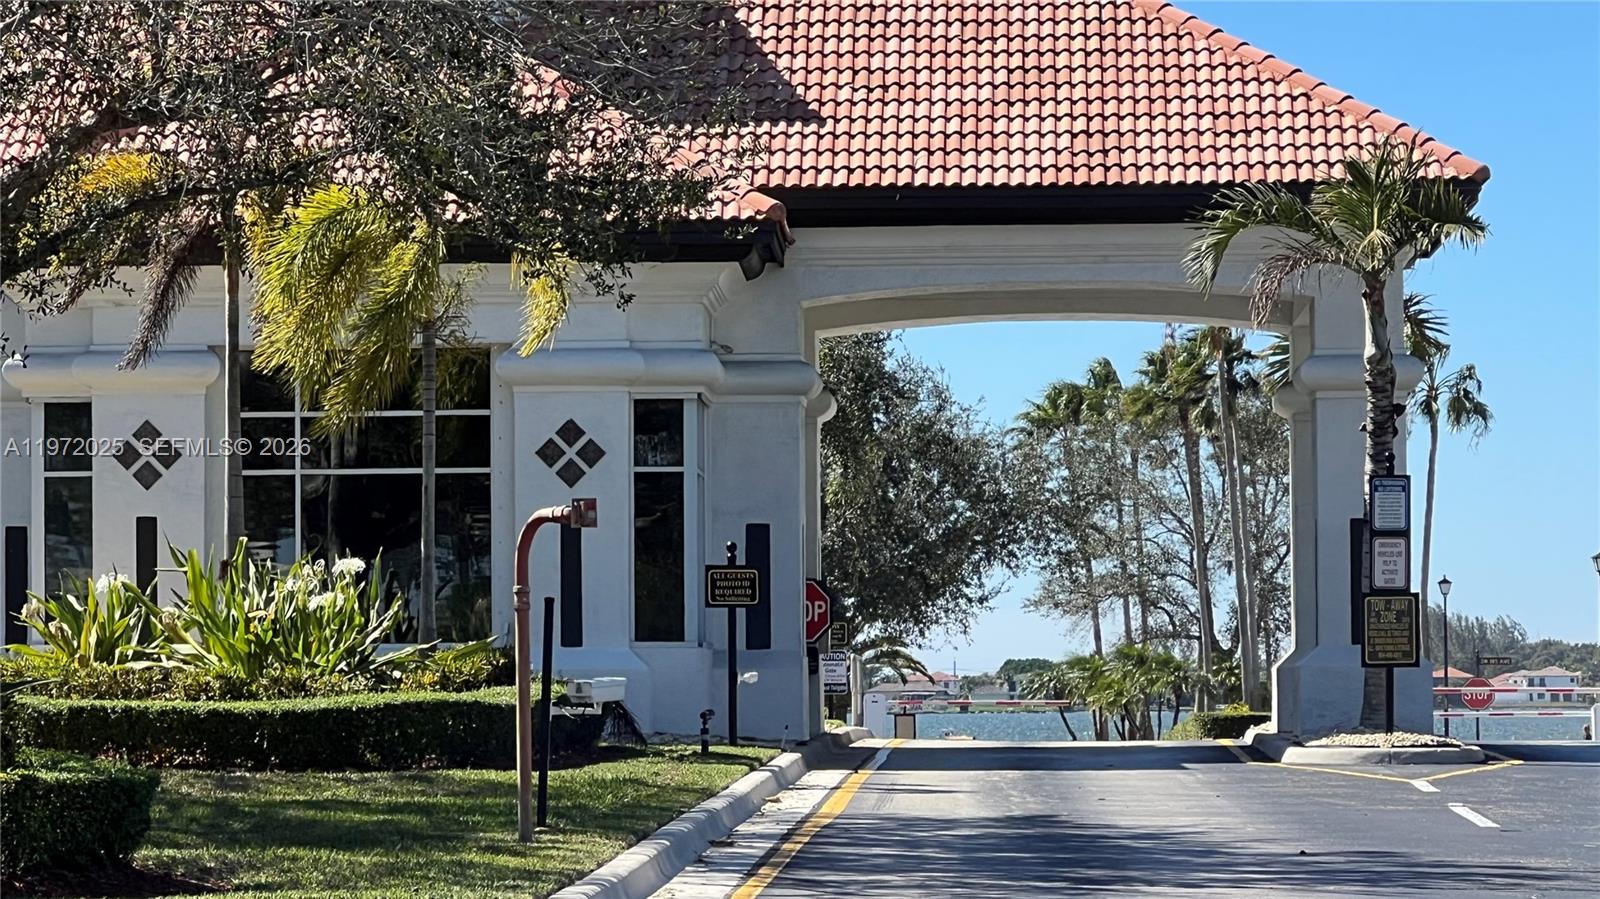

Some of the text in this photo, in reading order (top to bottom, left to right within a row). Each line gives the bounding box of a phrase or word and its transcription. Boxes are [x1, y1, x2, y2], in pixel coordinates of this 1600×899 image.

[715, 588, 752, 596] REQUIRED
[1370, 600, 1386, 611] TOW
[1391, 599, 1409, 611] AWAY
[806, 601, 826, 622] OP
[1380, 611, 1397, 623] ZONE
